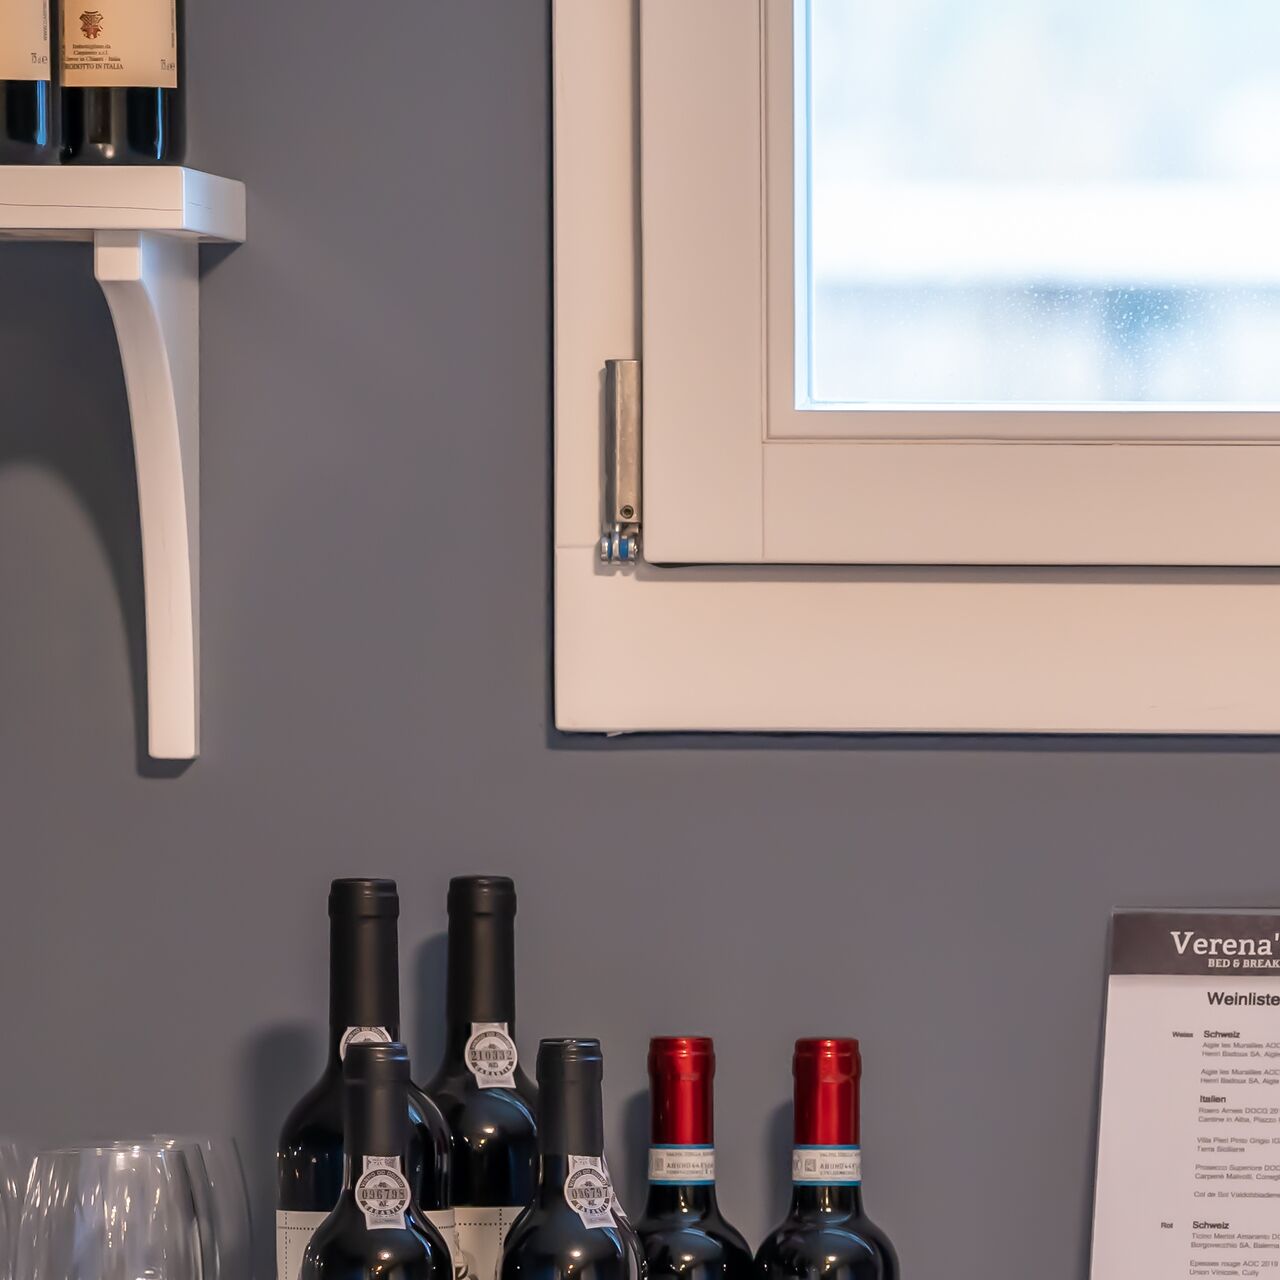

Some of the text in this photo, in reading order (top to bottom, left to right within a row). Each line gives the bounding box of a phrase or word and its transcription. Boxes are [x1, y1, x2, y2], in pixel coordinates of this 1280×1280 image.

[1207, 958, 1231, 968] BED
[1233, 959, 1240, 968] &
[1207, 991, 1280, 1006] Weinliste
[1203, 1030, 1240, 1038] Schweiz
[1199, 1095, 1226, 1103] Italien
[1192, 1221, 1229, 1229] Schweiz
